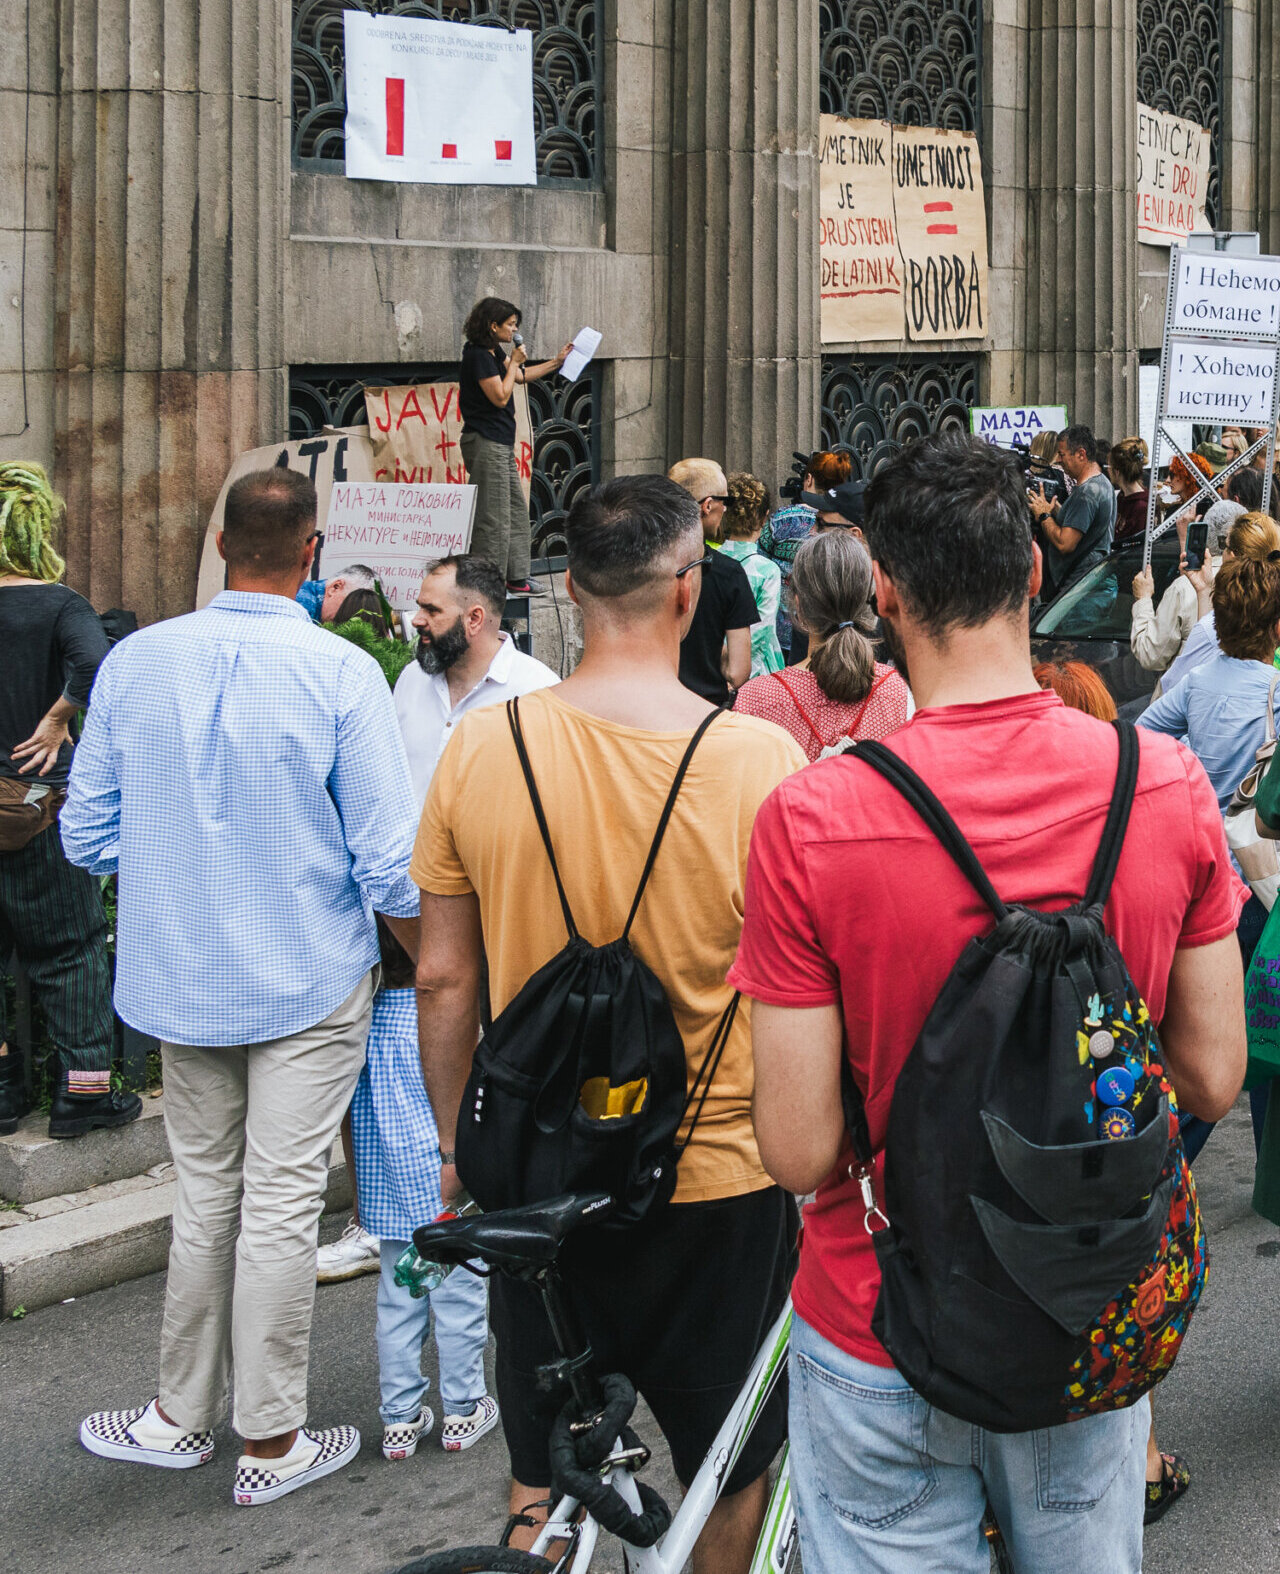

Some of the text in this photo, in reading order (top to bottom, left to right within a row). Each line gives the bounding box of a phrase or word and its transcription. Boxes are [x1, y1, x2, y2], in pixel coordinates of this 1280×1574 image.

[516, 43, 527, 52] NA
[1138, 113, 1201, 164] ETNIČKI
[896, 142, 975, 192] UMETNOST
[1152, 157, 1166, 190] JE
[1172, 163, 1199, 200] DRU
[837, 182, 856, 210] JE
[1168, 199, 1195, 232] RAD
[821, 256, 901, 288] DELATNIK
[1198, 266, 1280, 293] Нећемо
[908, 250, 983, 334] BORBA
[1182, 299, 1262, 323] обмане
[1191, 354, 1273, 379] Хоћемо
[374, 386, 461, 433] JAV
[1178, 389, 1253, 413] истину
[395, 489, 463, 510] ГОЈКОВИЋ
[367, 511, 432, 528] МИНИСТАРКА
[410, 530, 463, 551] НЕПОТИЗМА
